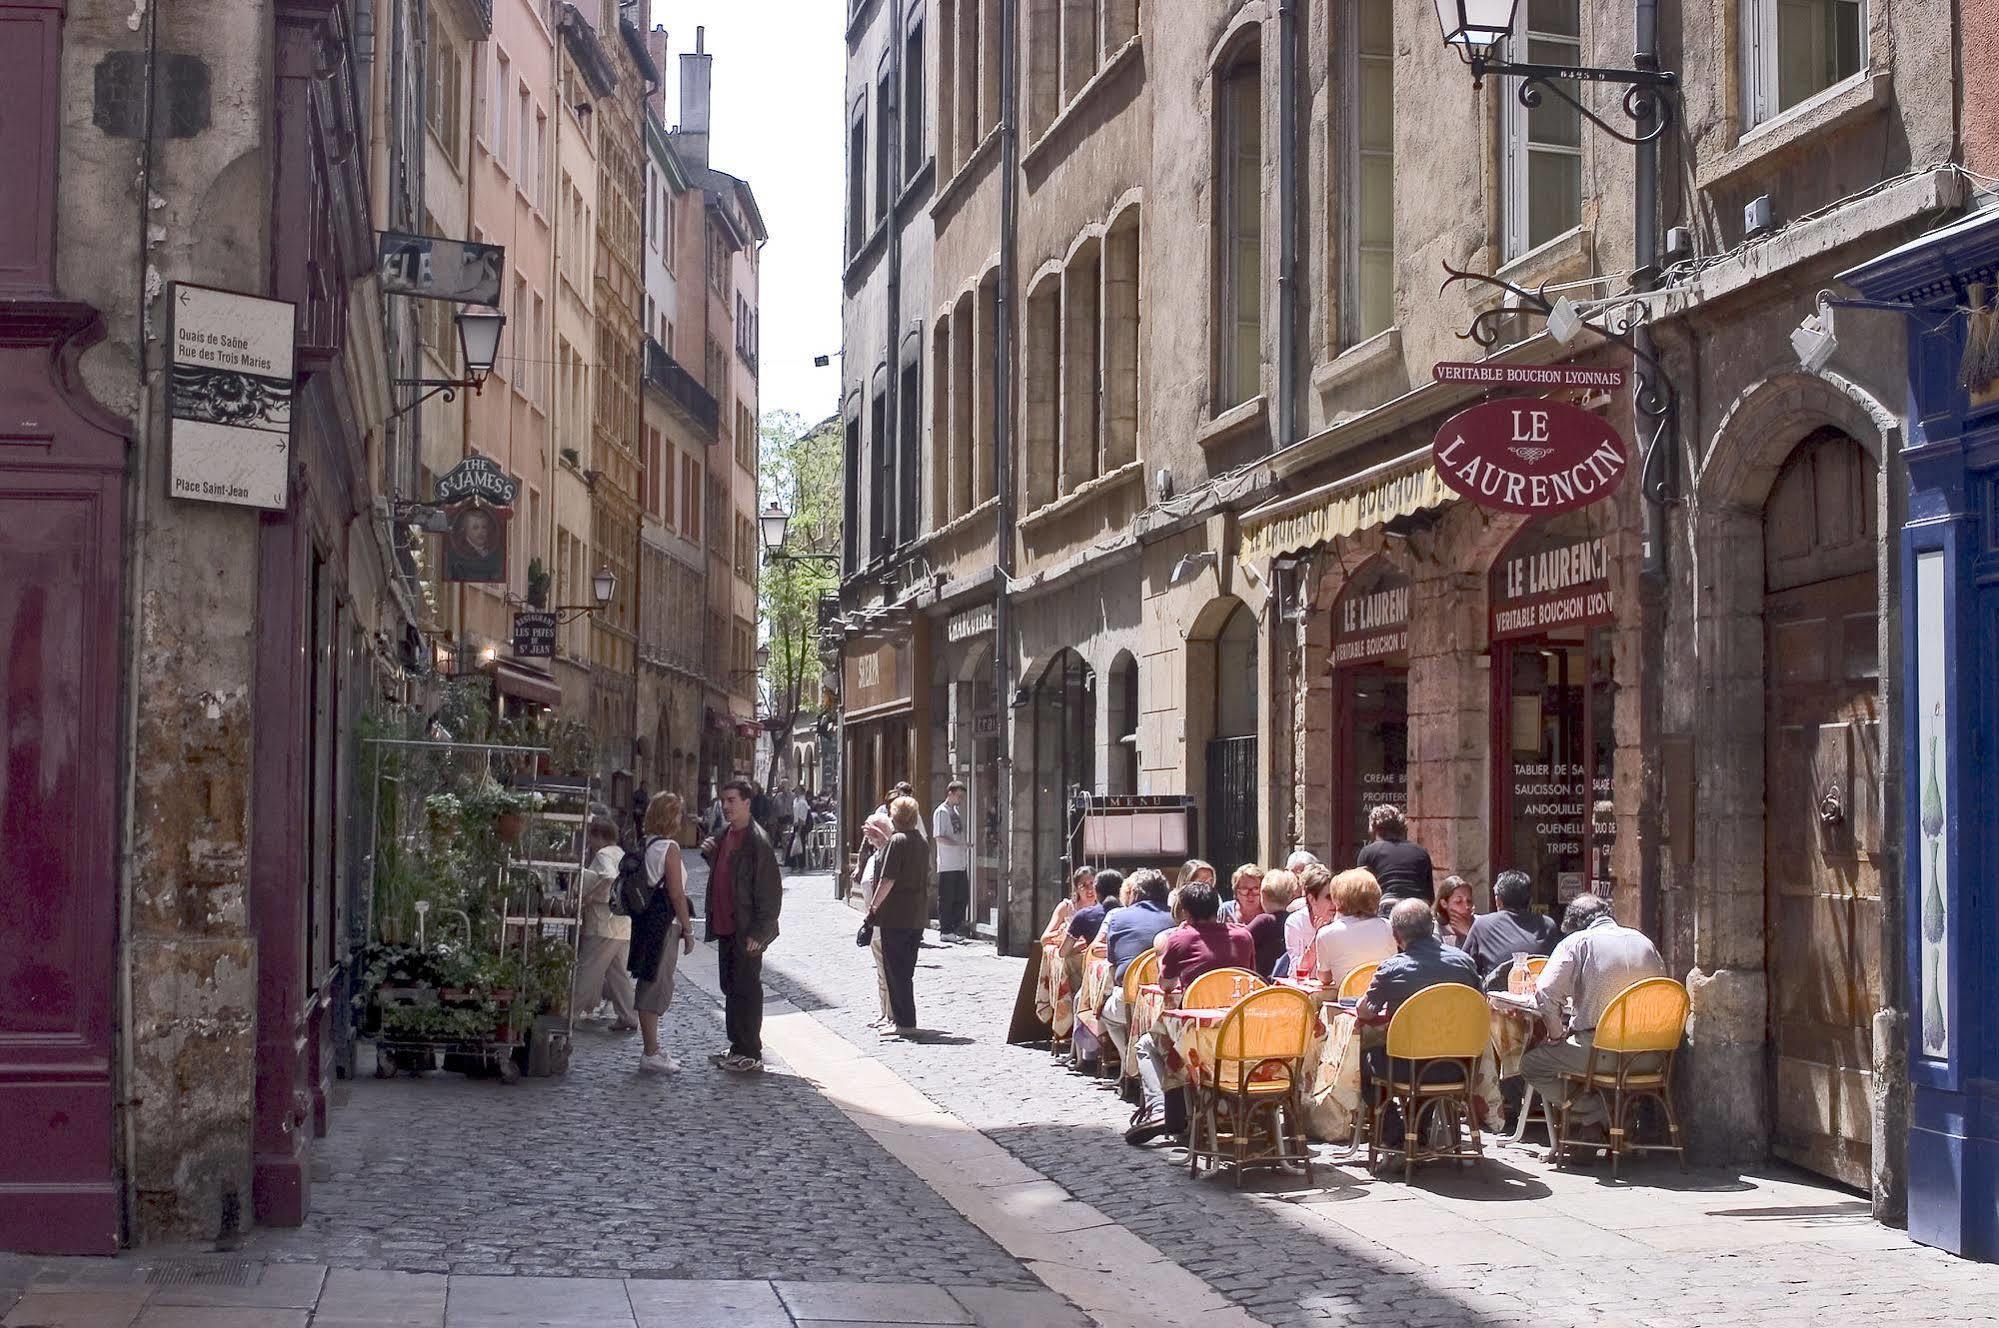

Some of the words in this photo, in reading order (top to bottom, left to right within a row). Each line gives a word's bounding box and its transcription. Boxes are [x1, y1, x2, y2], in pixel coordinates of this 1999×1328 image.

[179, 328, 205, 343] Quais
[207, 333, 218, 345] de
[220, 334, 249, 350] Saône
[178, 344, 196, 358] Rue
[199, 348, 215, 361] des
[217, 350, 239, 365] Trois
[241, 354, 271, 370] Maries
[1437, 366, 1503, 380] VERITABLE
[1507, 369, 1561, 383] BOUCHON
[1564, 371, 1621, 385] LYONNAIS
[1511, 410, 1549, 442] LE
[465, 459, 488, 470] THE
[1438, 434, 1625, 507] LAURENCIN
[176, 478, 200, 492] Place
[202, 481, 249, 498] Saint-Jean
[1507, 558, 1523, 598] LE
[1344, 599, 1356, 632] LE
[1496, 606, 1535, 632] VERITABLE
[1538, 597, 1583, 625] BOUCHON
[530, 644, 550, 654] JEAN
[1366, 634, 1398, 656] BOUCHON
[1363, 774, 1394, 784] CREME
[1514, 764, 1549, 775] TABLIER
[1554, 764, 1567, 775] DE
[1514, 784, 1571, 795] SAUCISSON
[1110, 797, 1161, 806] MENU
[1547, 843, 1579, 854] TRIPES
